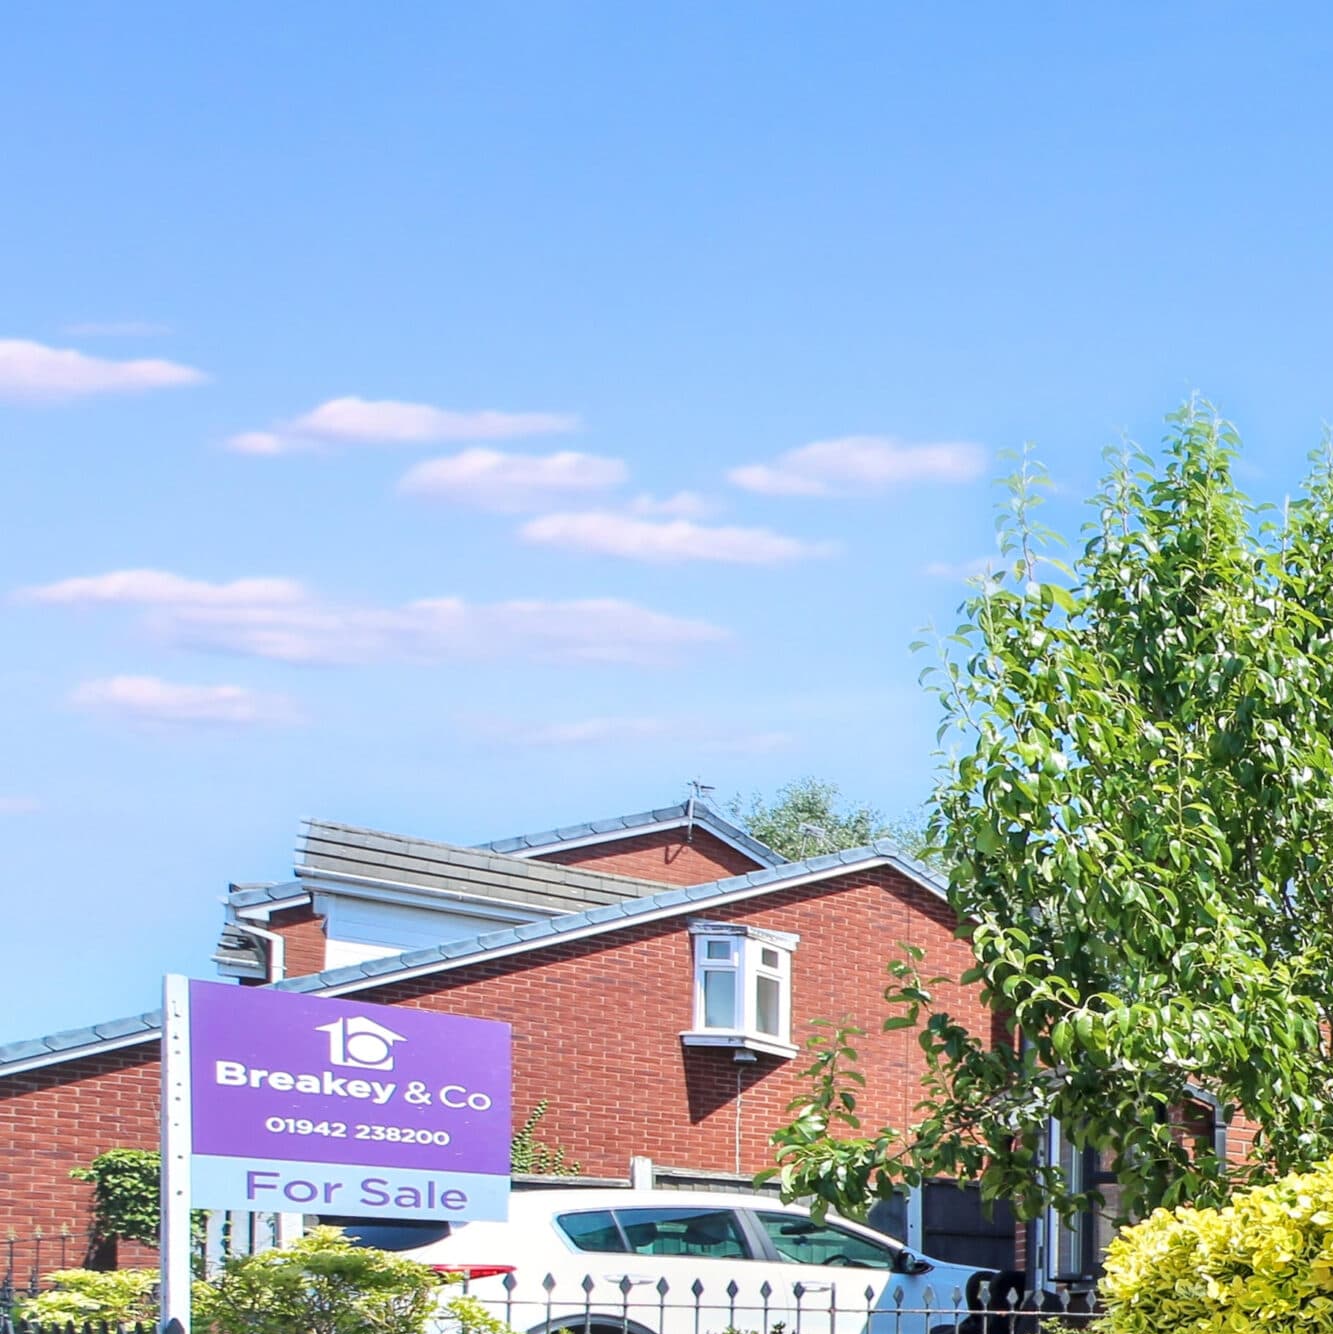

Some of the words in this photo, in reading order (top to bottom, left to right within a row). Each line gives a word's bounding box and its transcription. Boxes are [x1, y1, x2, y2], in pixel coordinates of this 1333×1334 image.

[216, 1060, 396, 1105] Breakey
[404, 1081, 432, 1105] &
[440, 1085, 492, 1111] Co
[265, 1117, 347, 1138] 01942
[355, 1125, 450, 1146] 238200
[247, 1171, 343, 1204] For
[360, 1178, 468, 1211] Sale
